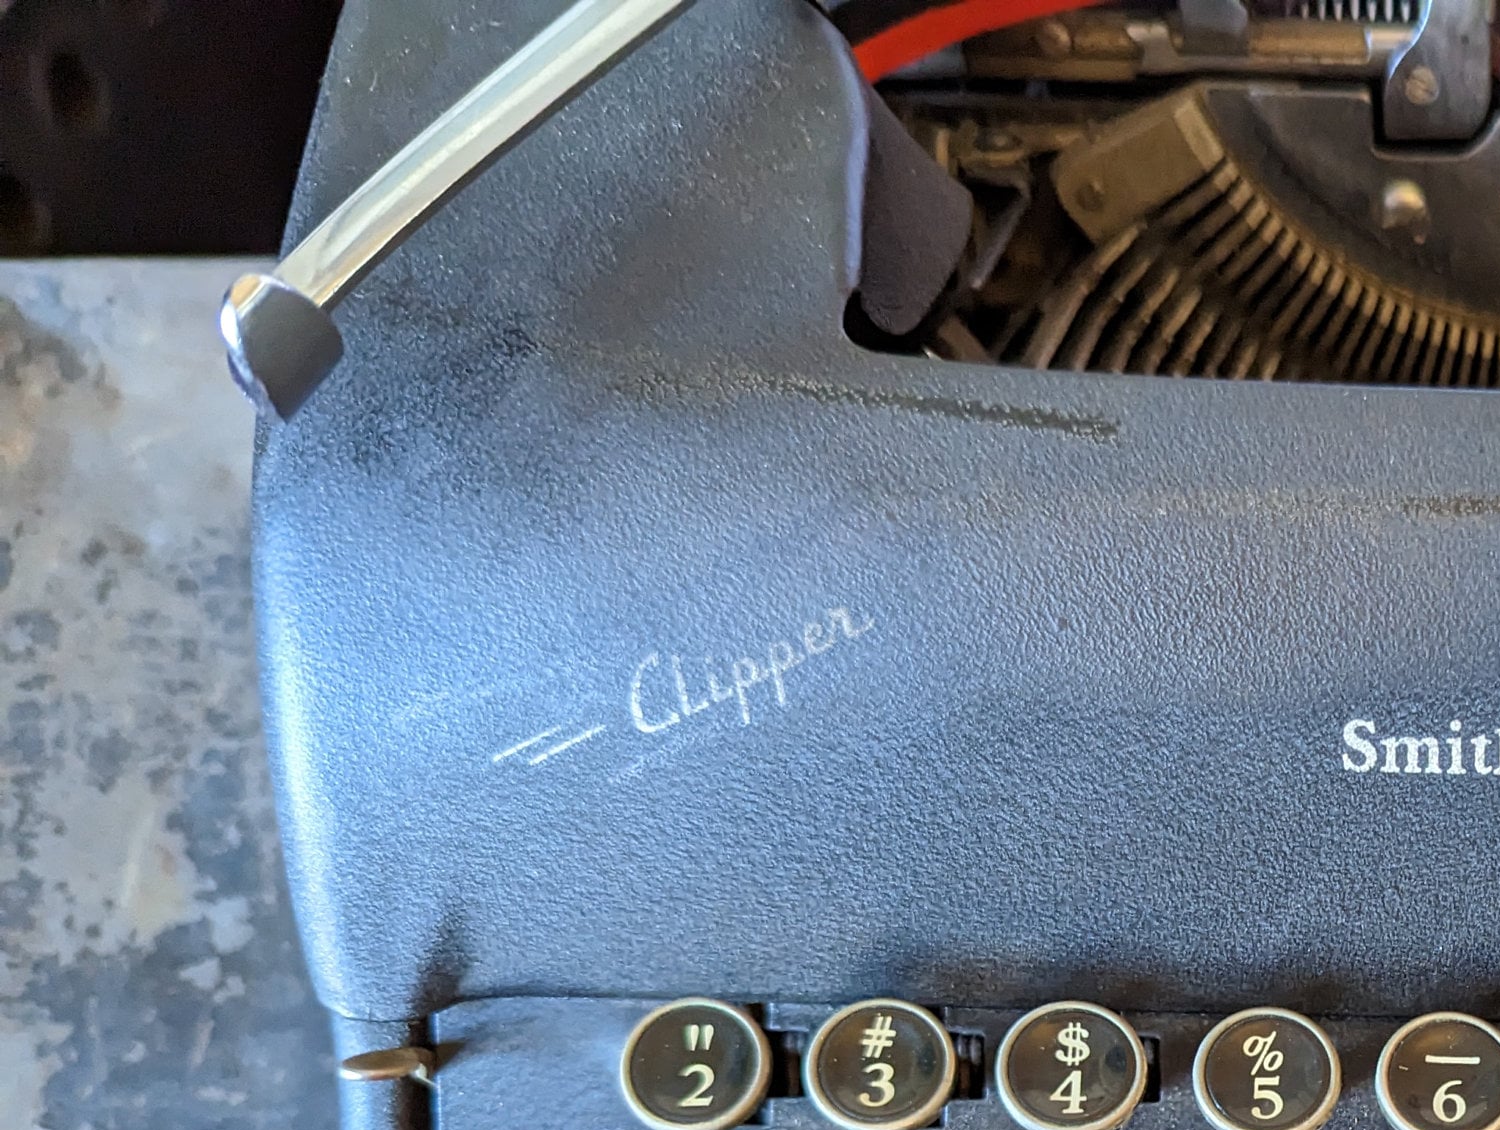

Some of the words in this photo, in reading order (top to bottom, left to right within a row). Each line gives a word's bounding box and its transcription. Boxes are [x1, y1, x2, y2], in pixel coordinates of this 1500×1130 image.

[630, 606, 875, 733] Clipper
[861, 1015, 896, 1059] #
[1055, 1022, 1091, 1066] $
[1242, 1030, 1284, 1076] %
[680, 1063, 716, 1107] 2
[858, 1063, 896, 1107] 3
[1049, 1070, 1088, 1114] 4
[1251, 1076, 1285, 1120] 5
[1431, 1079, 1467, 1123] 6
